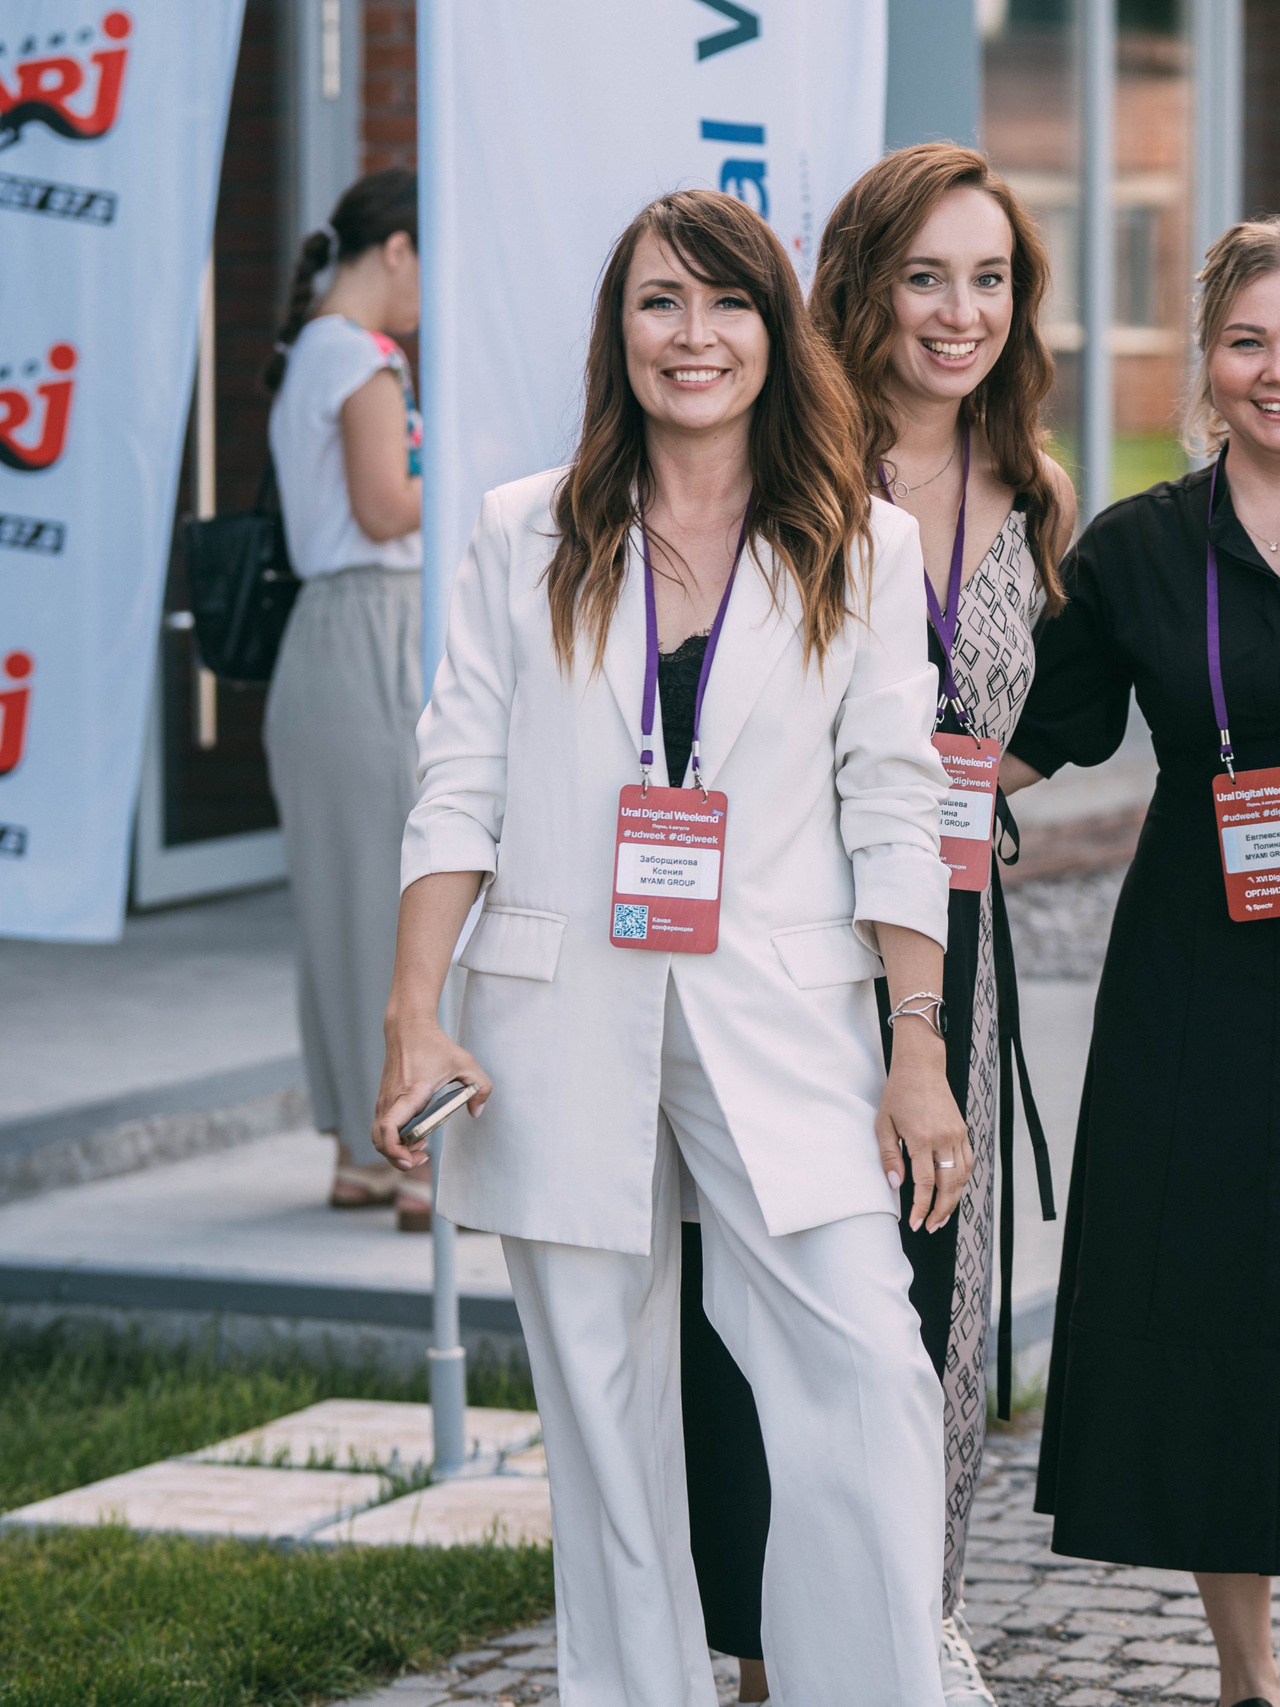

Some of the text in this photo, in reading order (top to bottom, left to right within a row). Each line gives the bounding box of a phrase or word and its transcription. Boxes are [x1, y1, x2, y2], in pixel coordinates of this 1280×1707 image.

[952, 756, 993, 769] Weekend
[952, 776, 991, 788] digiweek
[1216, 792, 1235, 802] Ural
[1235, 788, 1264, 801] Digital
[621, 807, 641, 818] Ural
[642, 809, 674, 822] Digital
[674, 811, 719, 824] Weekend
[1222, 811, 1261, 822] #udweek
[944, 819, 970, 828] GROUP
[623, 829, 719, 844] #udweek #digiweek
[640, 855, 698, 866] Заборщикова
[1245, 852, 1268, 861] MYAMI
[652, 867, 683, 876] Ксения
[640, 877, 695, 887] MYAMI GROUP
[1255, 875, 1268, 883] XVI
[652, 924, 693, 933] конференции
